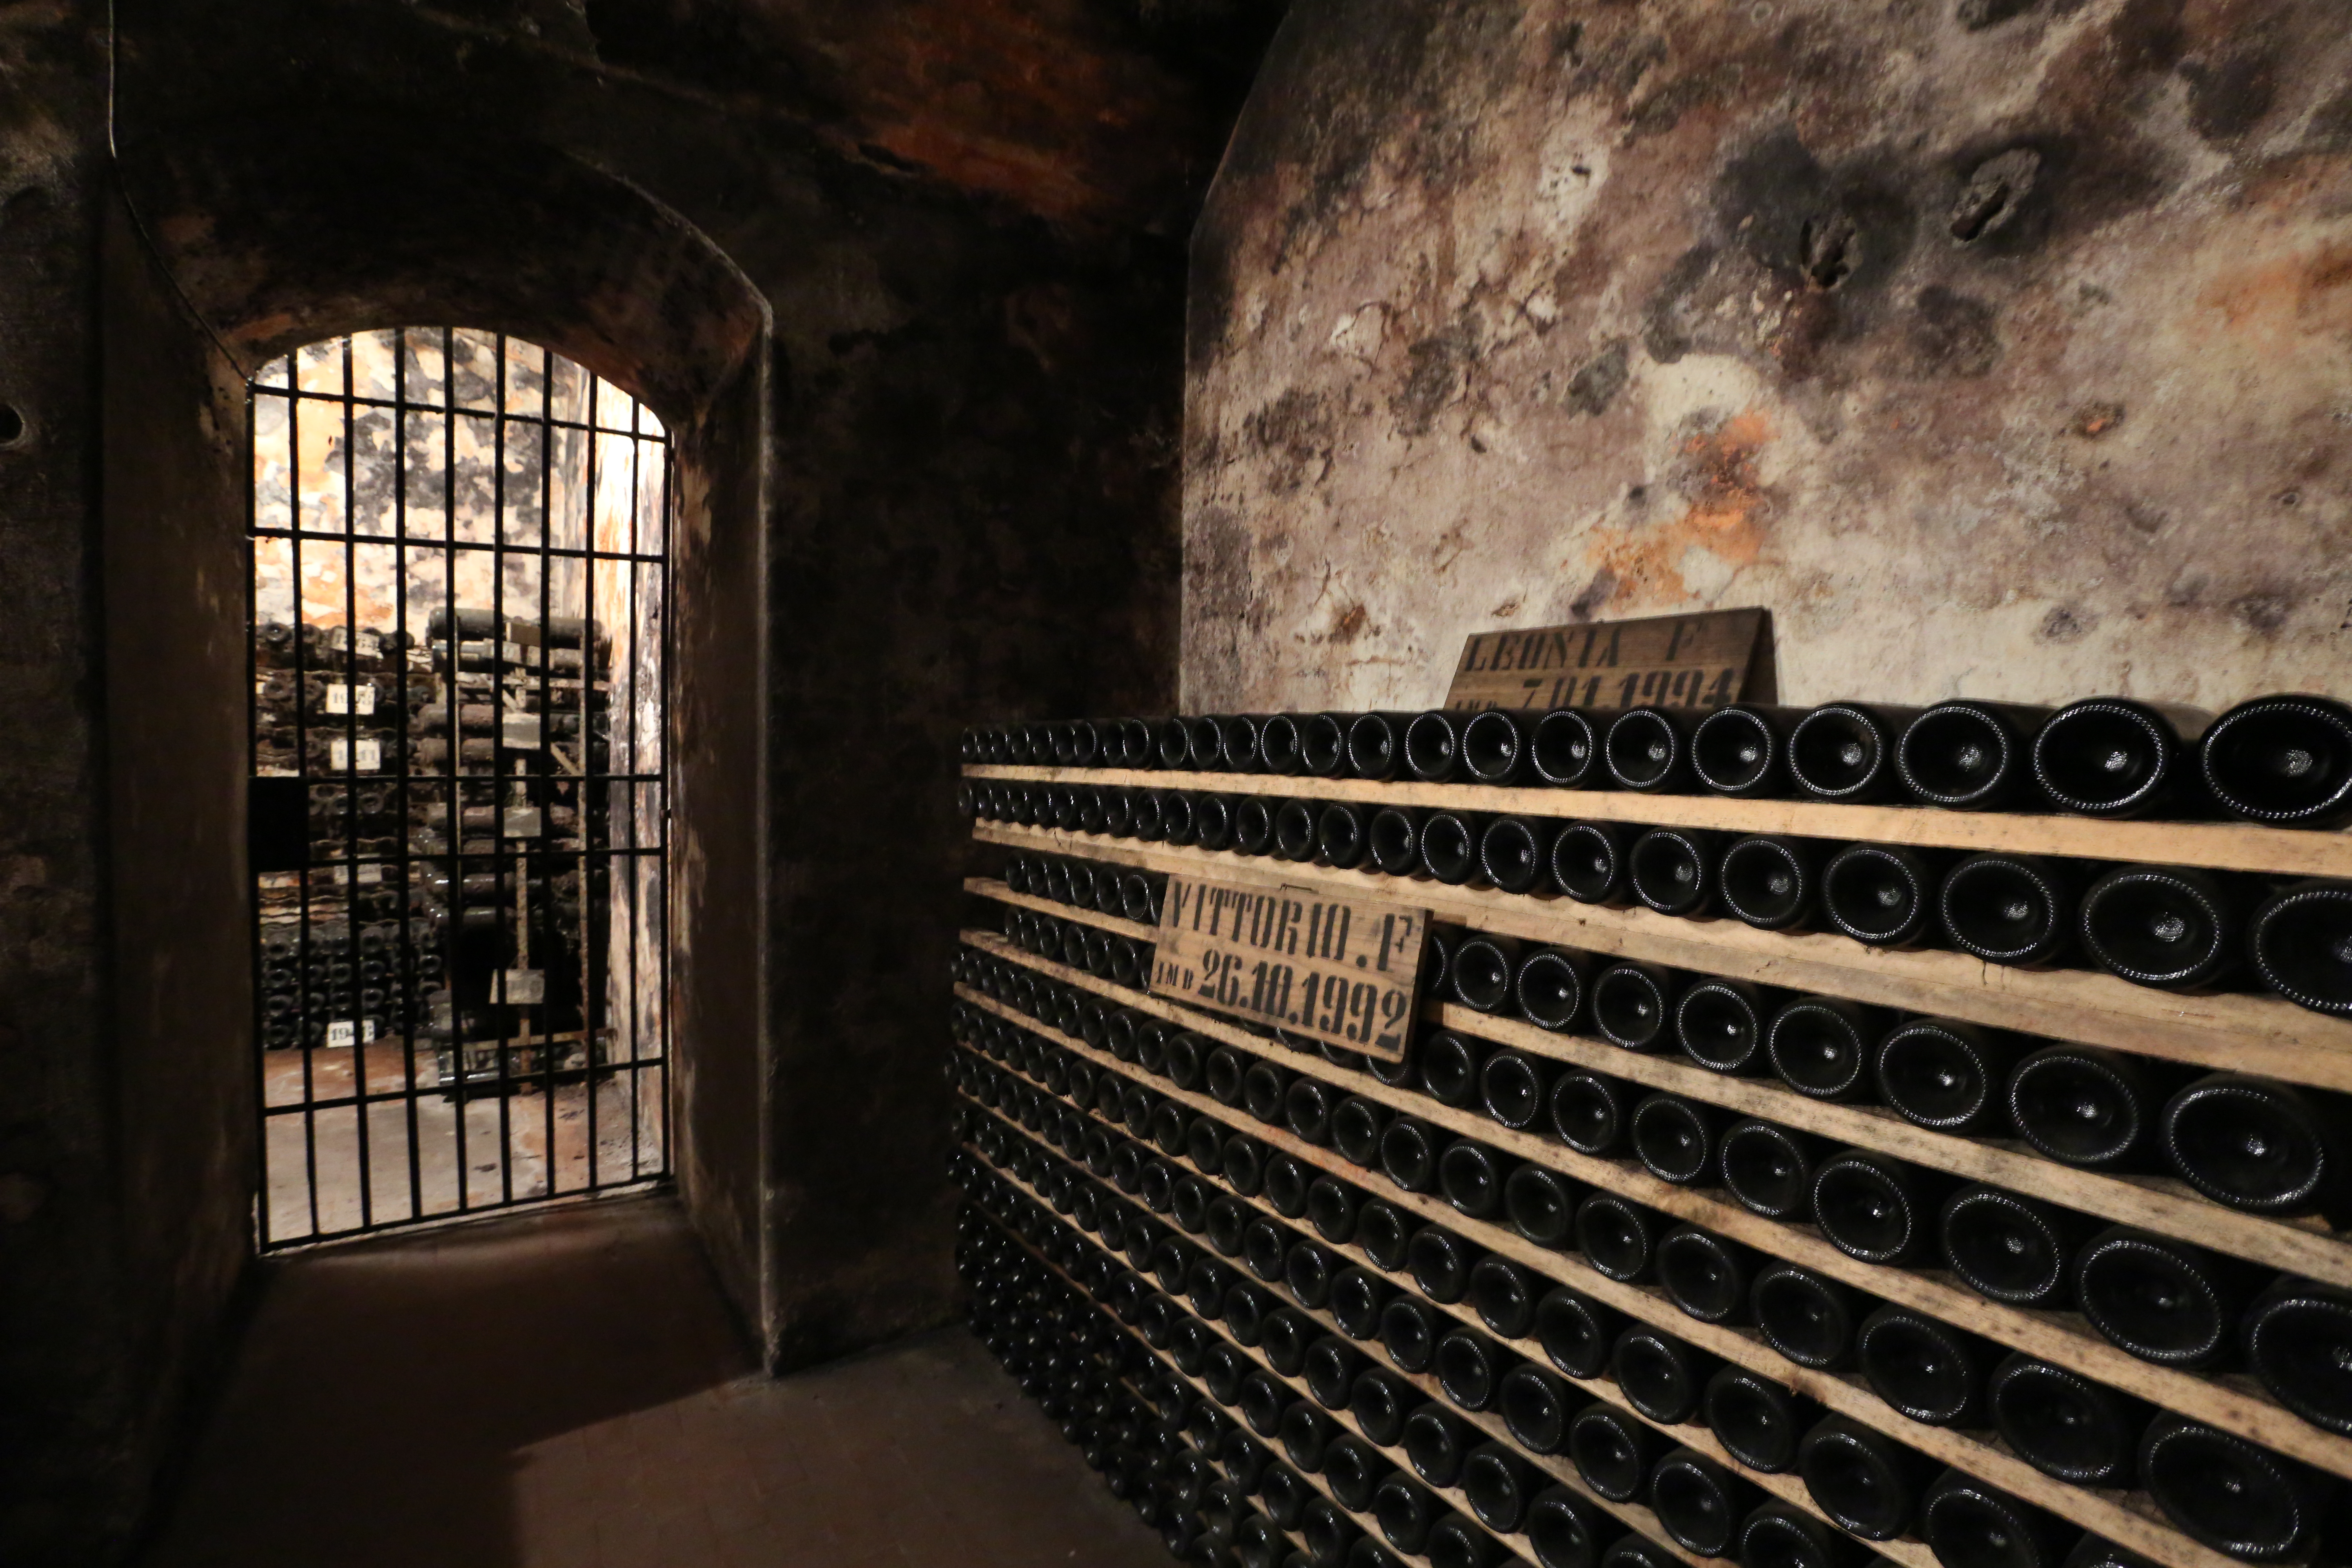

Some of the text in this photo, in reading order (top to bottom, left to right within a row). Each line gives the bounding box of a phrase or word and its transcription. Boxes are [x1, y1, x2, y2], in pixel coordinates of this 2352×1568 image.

[1465, 626, 1621, 671] LEONIA
[1377, 913, 1413, 971] F
[1198, 948, 1406, 1051] 26.10.1992
